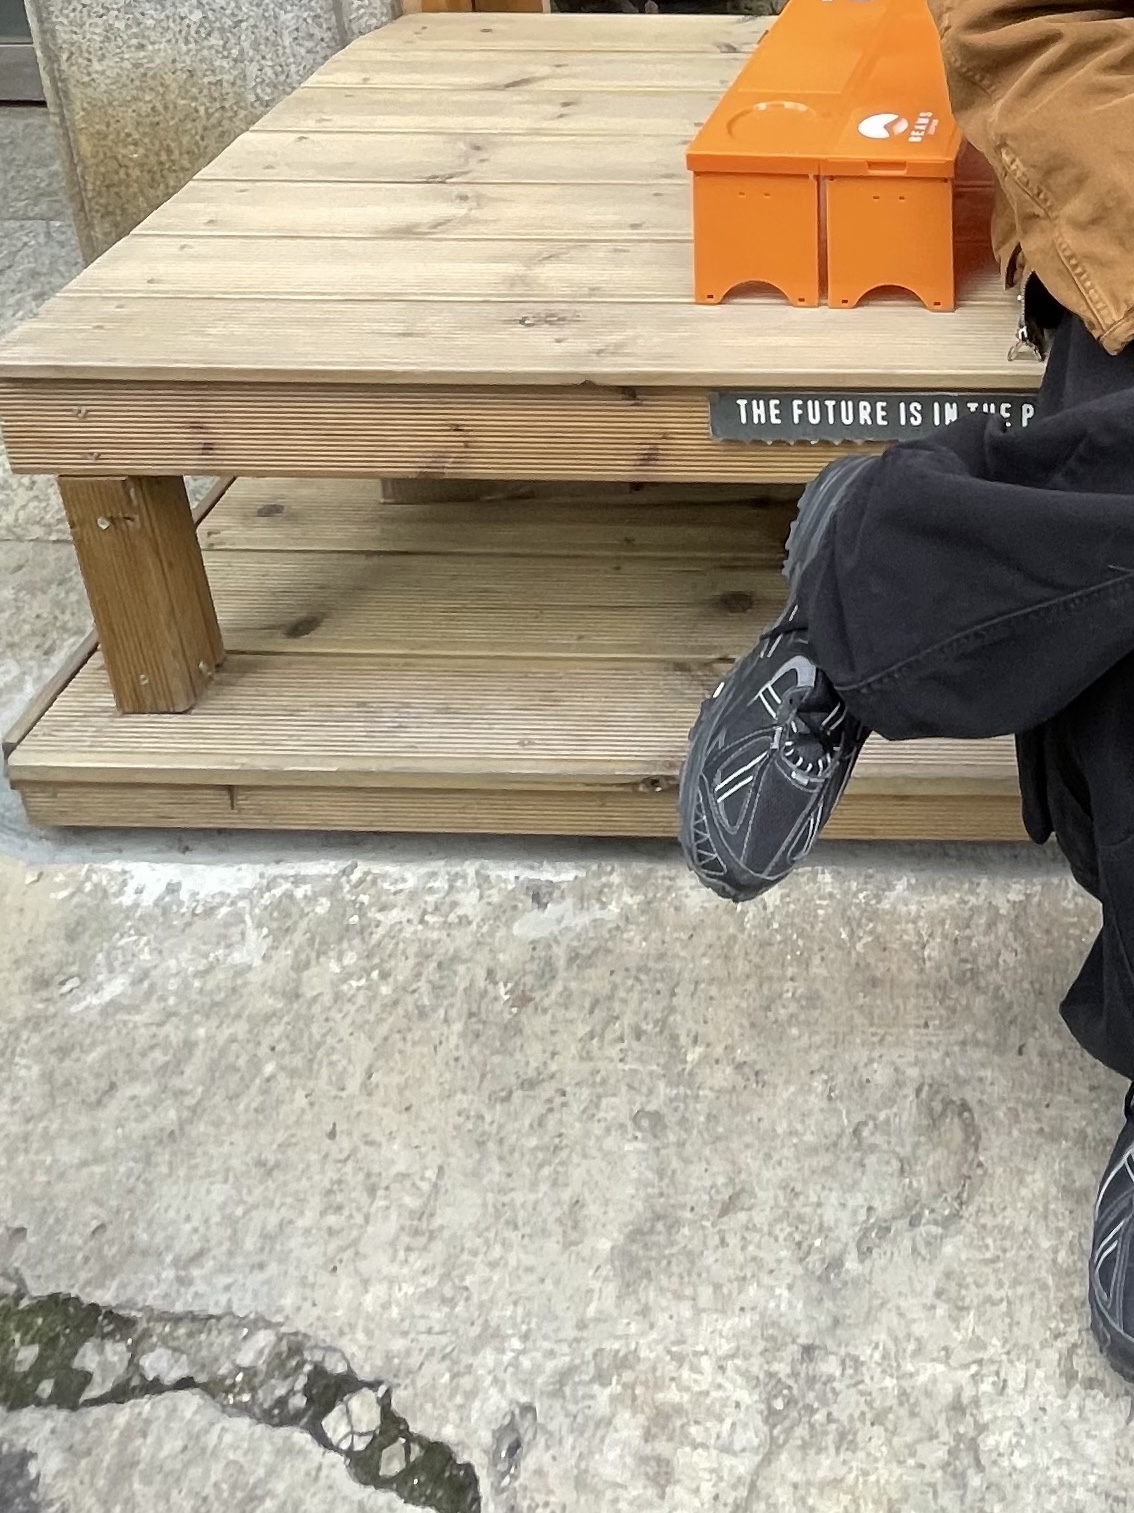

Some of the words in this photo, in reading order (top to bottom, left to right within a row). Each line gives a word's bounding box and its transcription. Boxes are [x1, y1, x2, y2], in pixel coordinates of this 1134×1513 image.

[736, 399, 782, 425] THE
[792, 399, 888, 426] FUTURE
[899, 401, 923, 426] IS
[933, 401, 958, 426] IN
